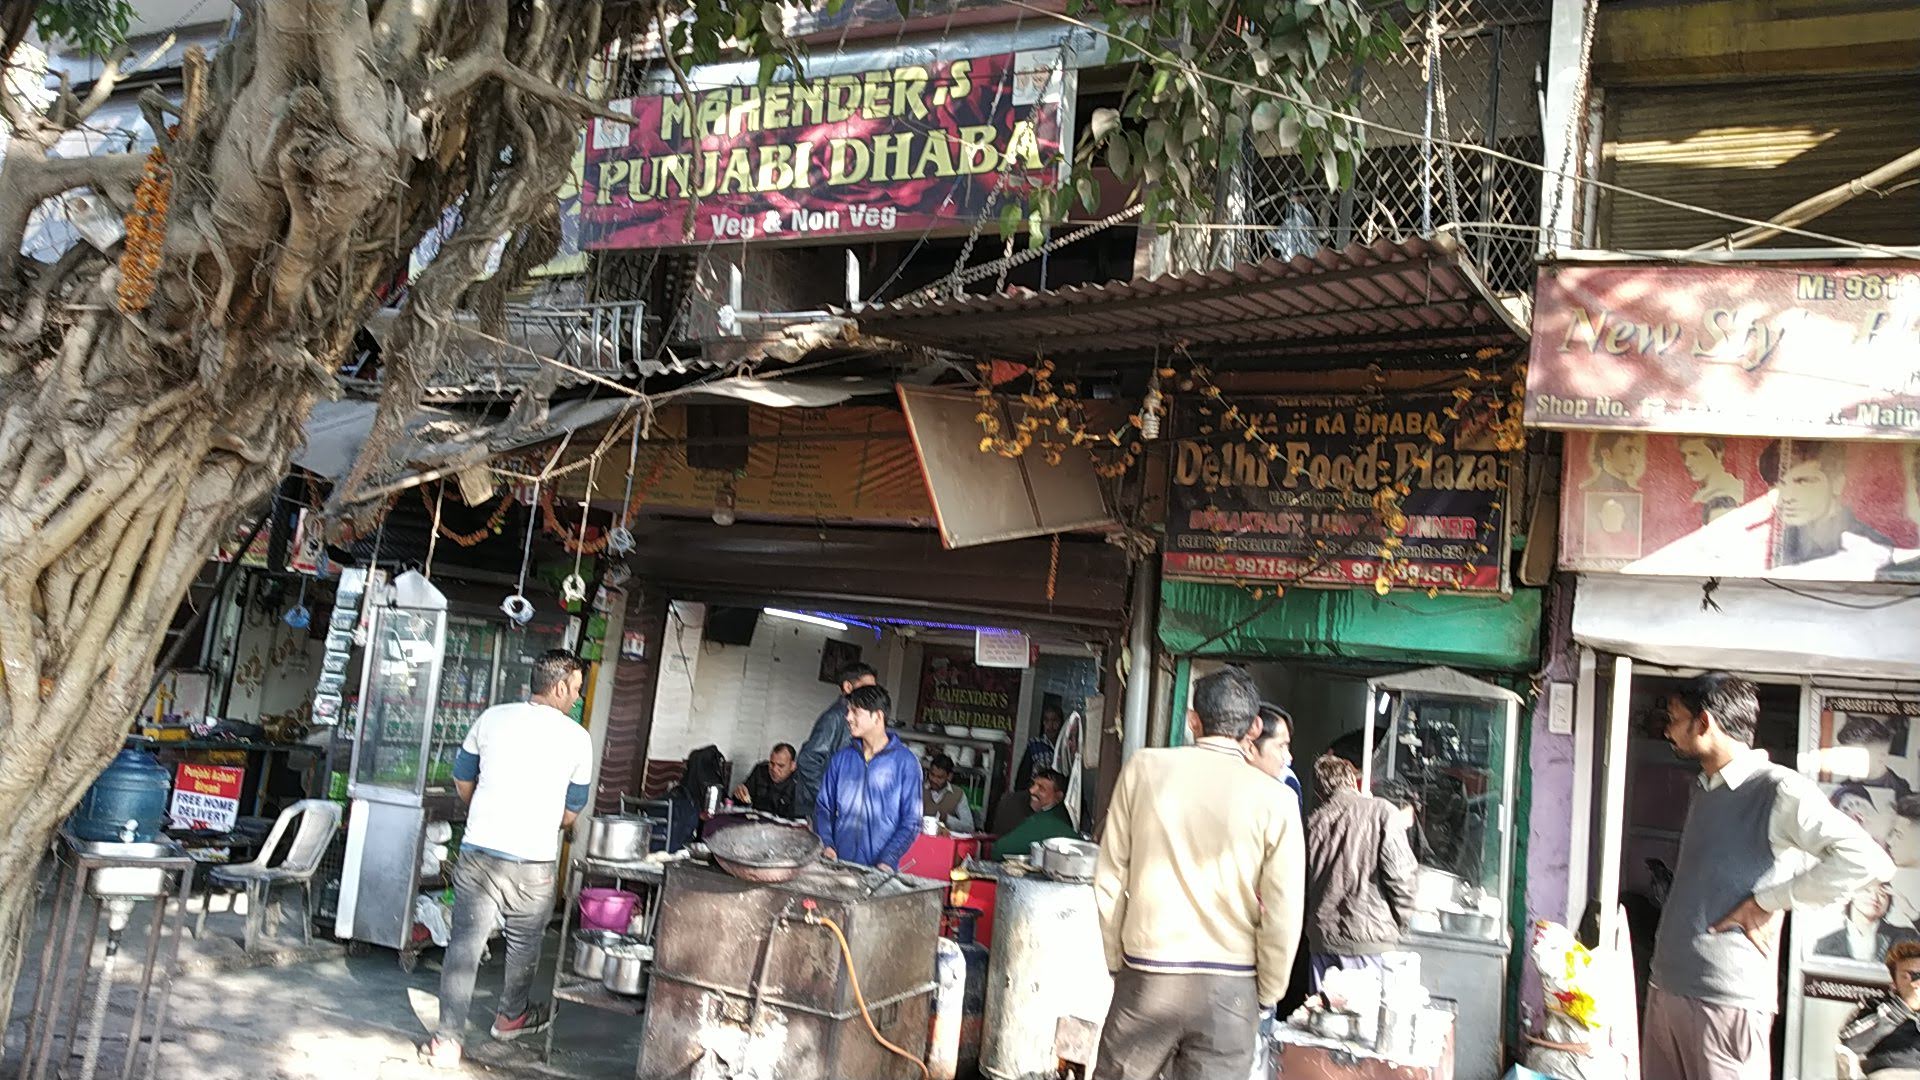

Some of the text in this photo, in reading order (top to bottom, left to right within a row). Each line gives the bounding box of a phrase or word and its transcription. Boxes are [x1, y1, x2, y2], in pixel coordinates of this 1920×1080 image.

[597, 141, 813, 204] PUNJABI
[826, 119, 1045, 188] DHABA
[710, 202, 898, 239] Veg & Non Veg
[1556, 308, 1682, 356] New
[1315, 415, 1347, 434] KA
[1352, 411, 1440, 437] DHABA
[1535, 394, 1589, 418] Shop
[1595, 395, 1631, 417] No.
[1856, 403, 1920, 426] Main
[1173, 440, 1500, 491] Delhi Food Plaza
[177, 793, 235, 812] FREE HOME
[178, 805, 229, 822] DELIVERY
